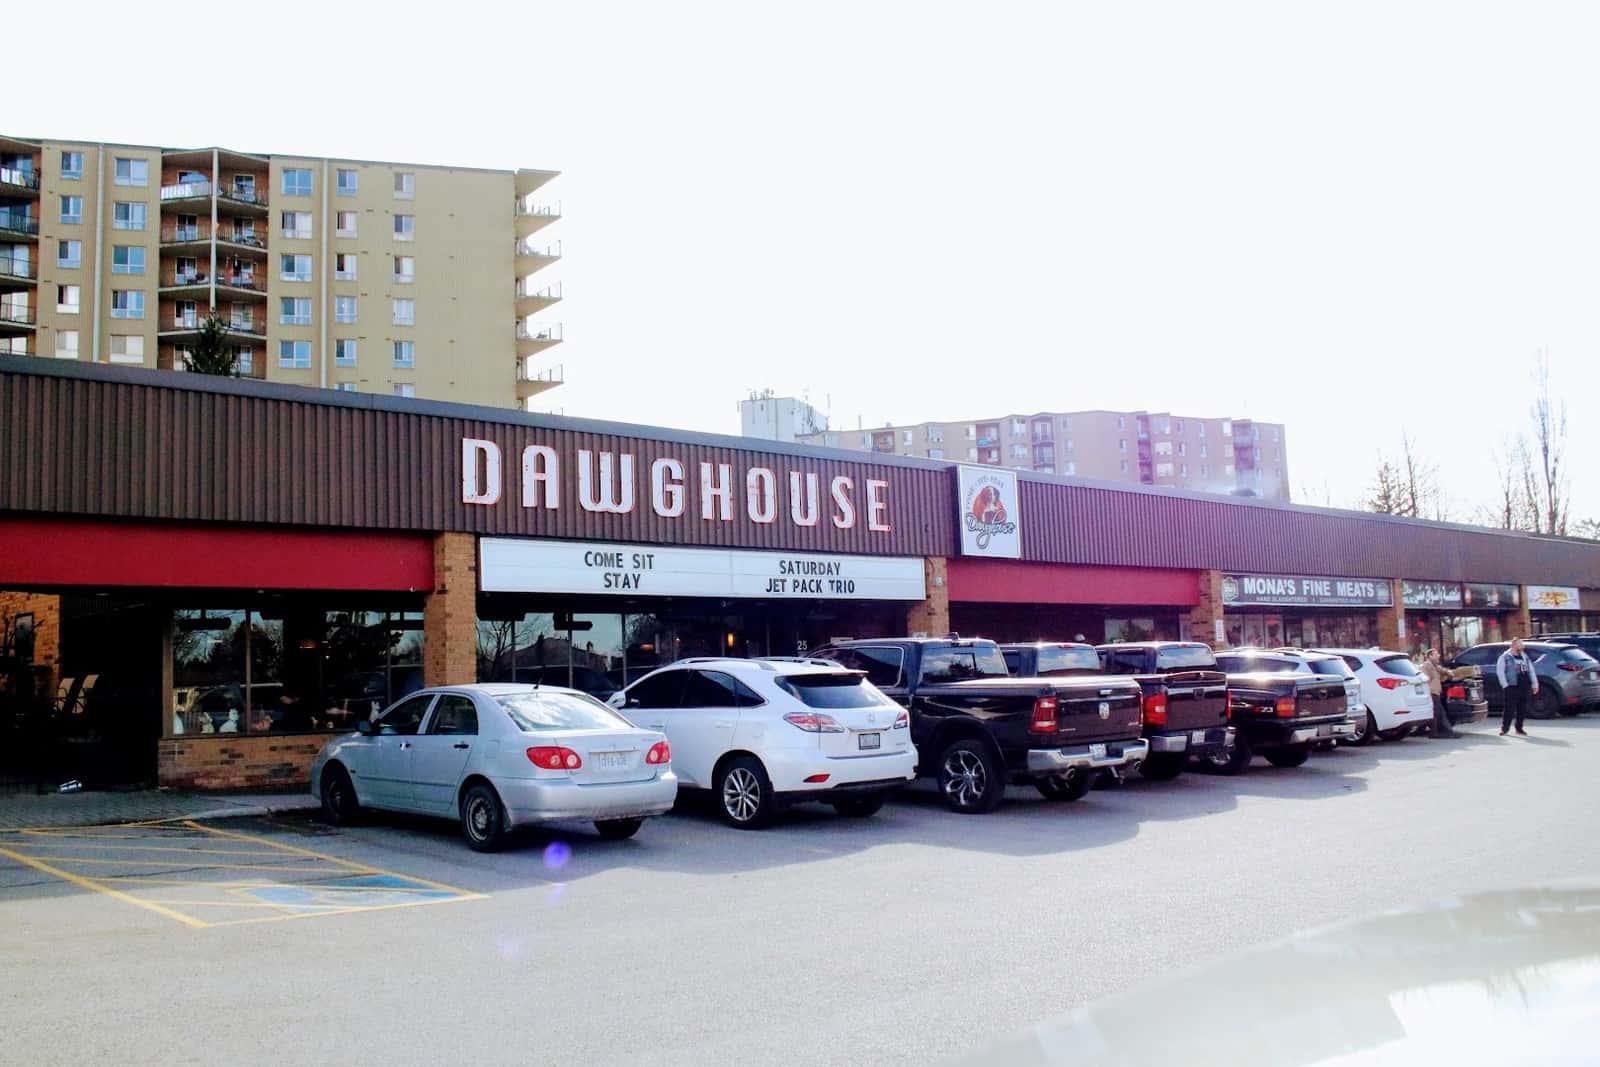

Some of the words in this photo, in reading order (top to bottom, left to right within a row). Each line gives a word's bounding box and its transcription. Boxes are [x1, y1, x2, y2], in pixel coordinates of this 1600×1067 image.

[462, 438, 891, 531] DAWGHOUSE
[584, 550, 624, 569] COME
[632, 553, 655, 570] SIT
[779, 559, 841, 576] SATURDAY
[603, 572, 641, 590] STAY
[765, 577, 787, 593] JET
[792, 578, 823, 593] PACK
[828, 579, 855, 594] TRIO
[1243, 577, 1296, 596] MONA'S
[1302, 580, 1332, 597] FINE
[1336, 581, 1375, 598] MEATS
[797, 640, 808, 651] 25
